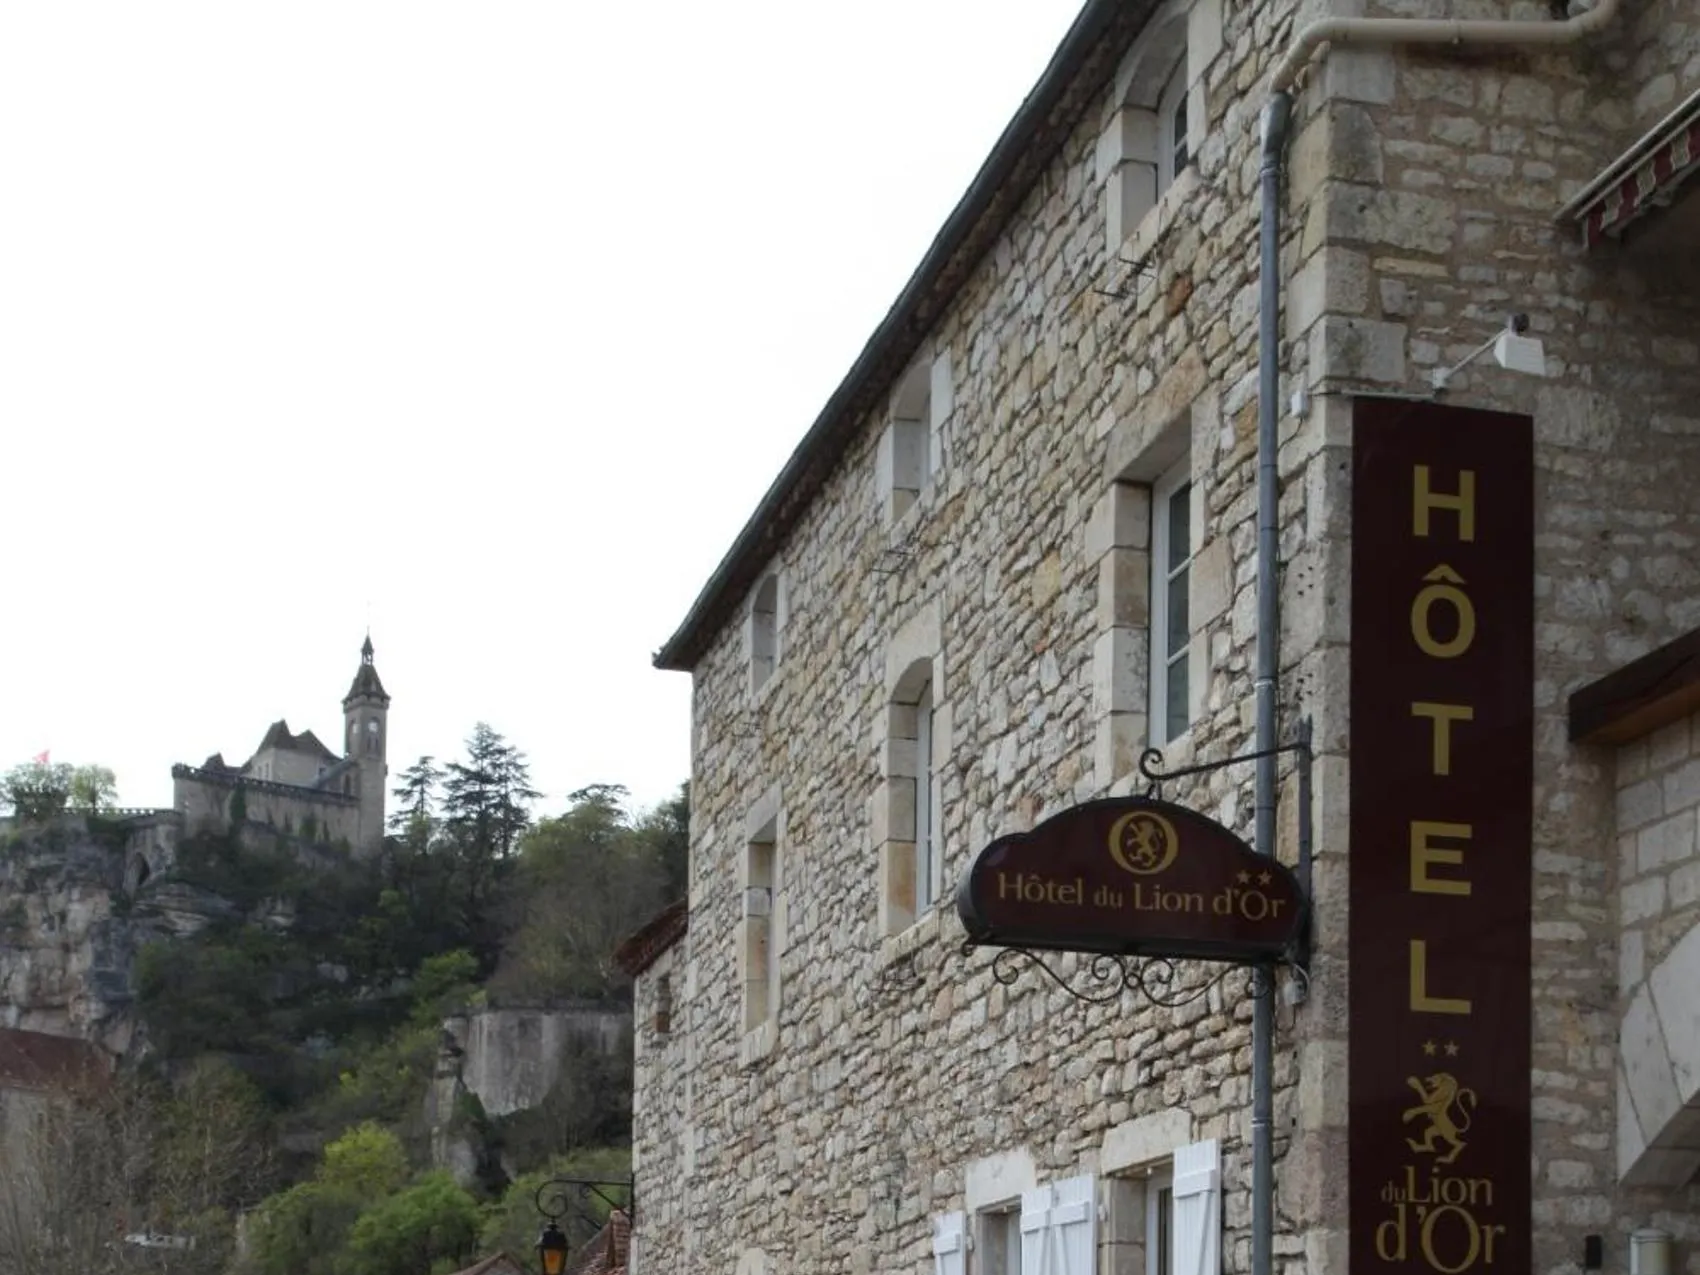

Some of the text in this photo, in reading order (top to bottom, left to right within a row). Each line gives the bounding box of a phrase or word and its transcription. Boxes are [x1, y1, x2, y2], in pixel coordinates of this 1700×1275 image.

[1409, 464, 1476, 1016] HÔTEL
[997, 870, 1287, 922] Hôtel du Lion d'Or
[1381, 1165, 1493, 1206] du Lion
[1376, 1203, 1506, 1275] d'Or
